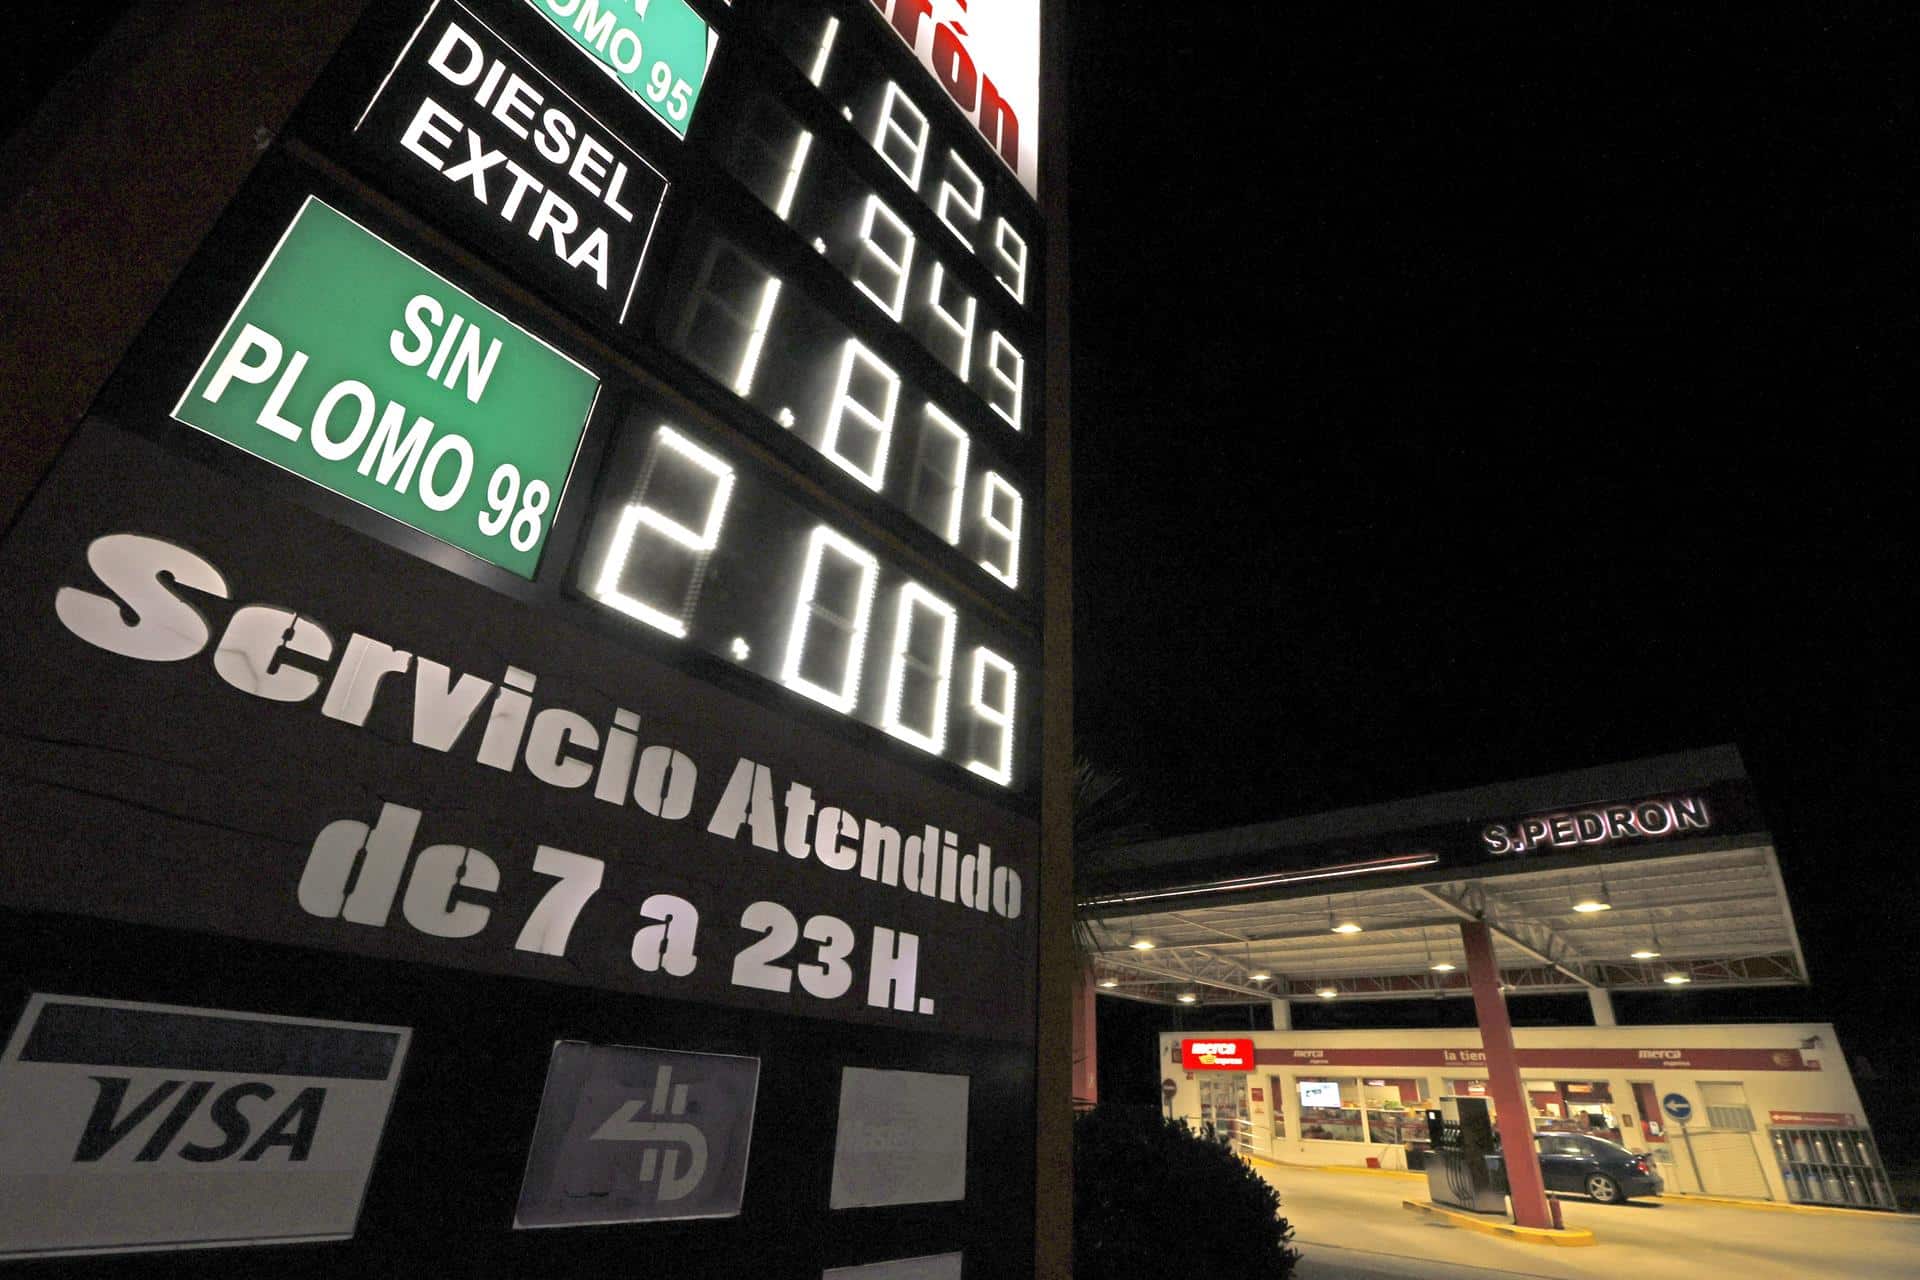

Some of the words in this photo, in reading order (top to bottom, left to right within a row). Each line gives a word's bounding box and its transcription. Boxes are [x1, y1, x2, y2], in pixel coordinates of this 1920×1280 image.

[400, 97, 608, 291] EXTRA
[427, 22, 634, 223] DIESEL
[646, 61, 693, 121] 95
[810, 17, 1027, 305] 1.829
[389, 294, 503, 404] SIN
[777, 130, 1024, 431] 1.949
[202, 322, 474, 512] PLOMO
[478, 463, 551, 552] 98
[734, 277, 1023, 589] 1.879
[595, 424, 1017, 786] 2.009
[55, 533, 698, 820] Servicio
[706, 757, 1022, 919] Atendido
[298, 801, 500, 938] de
[515, 844, 605, 957] 7
[631, 894, 700, 977] a
[731, 901, 856, 1000] 23
[867, 925, 935, 1015] H.
[72, 1075, 328, 1162] VISA
[1459, 1049, 1487, 1061] tien
[1638, 1049, 1682, 1060] merca
